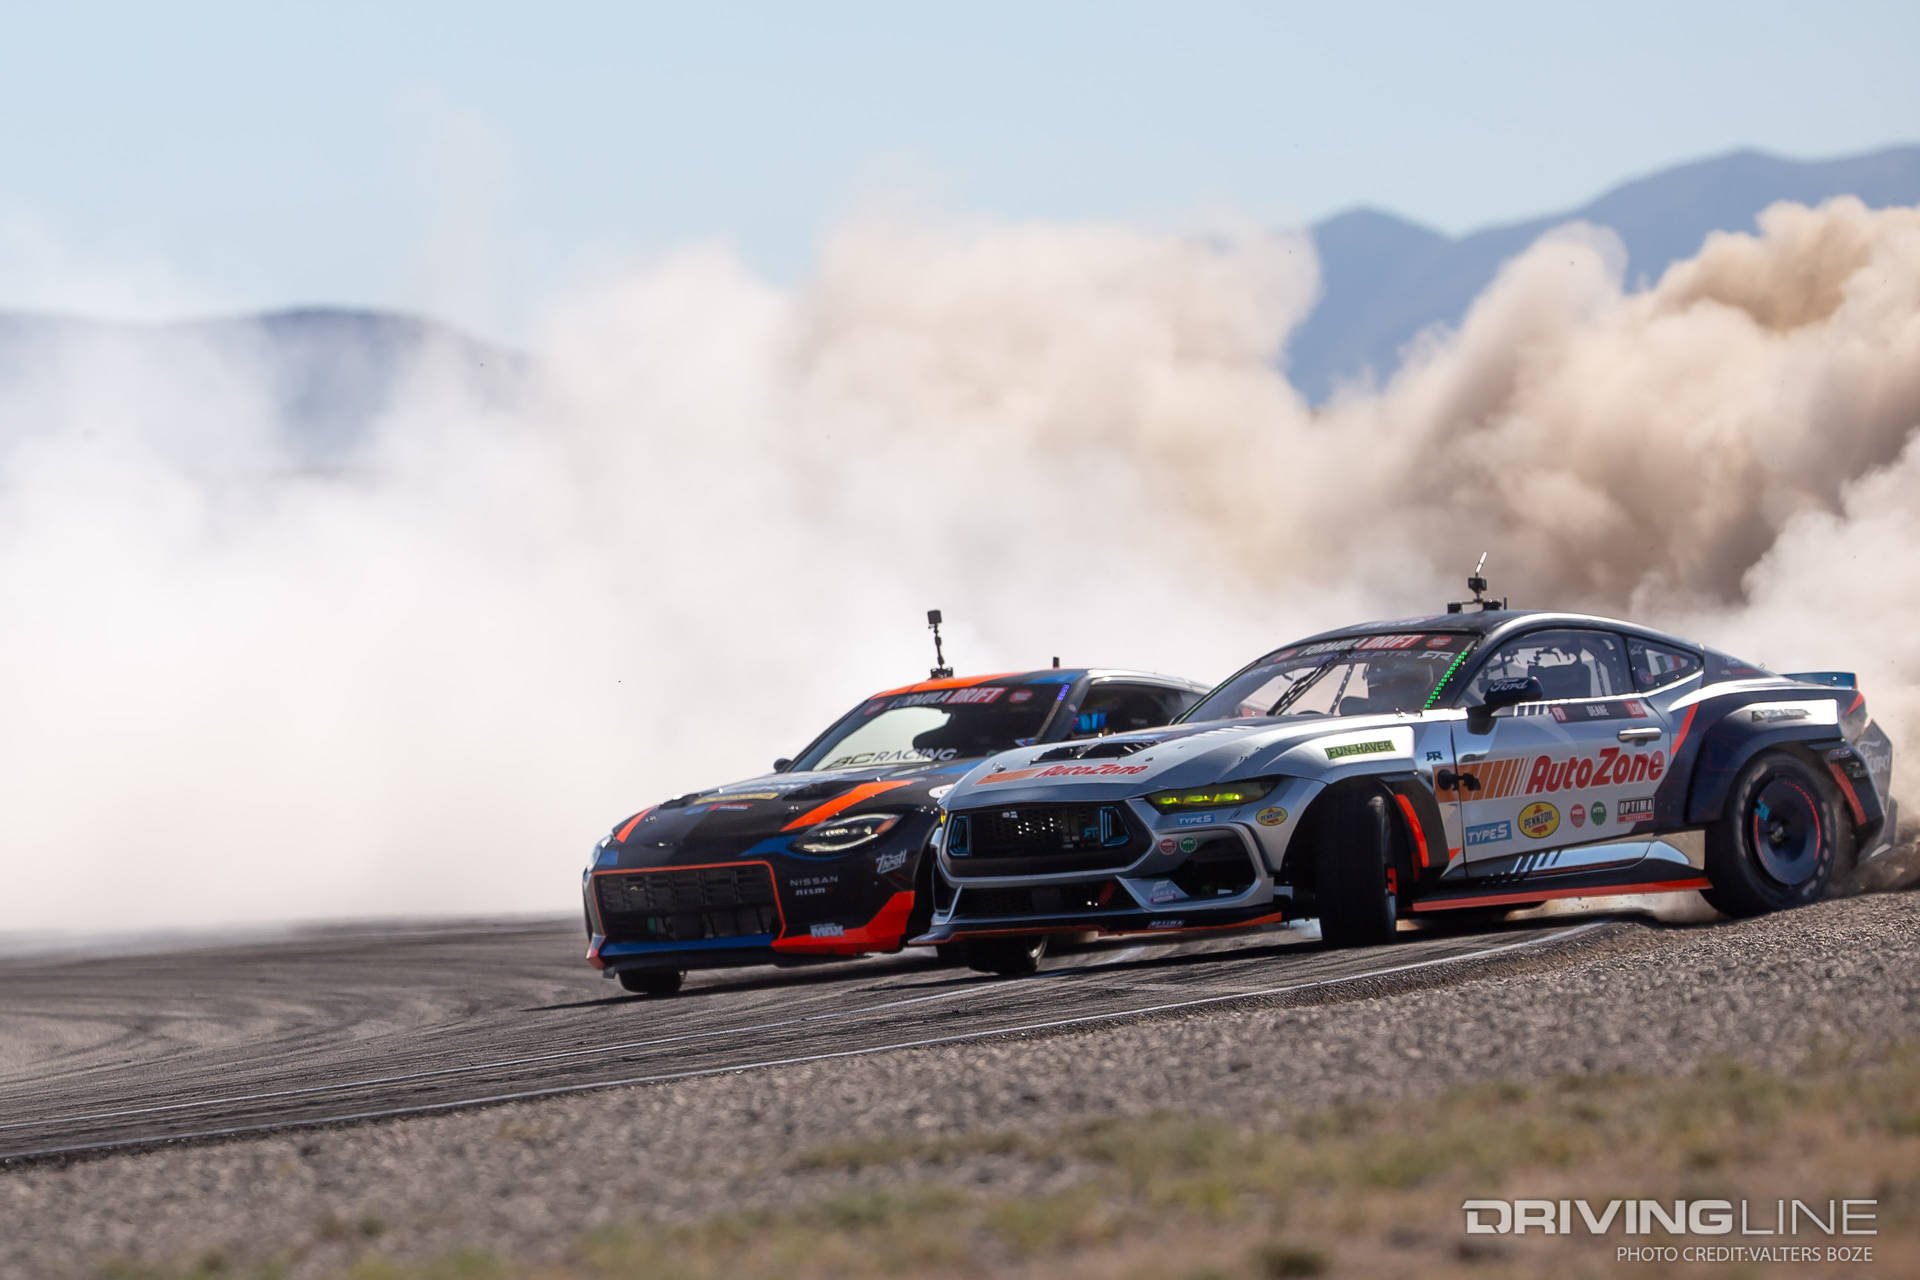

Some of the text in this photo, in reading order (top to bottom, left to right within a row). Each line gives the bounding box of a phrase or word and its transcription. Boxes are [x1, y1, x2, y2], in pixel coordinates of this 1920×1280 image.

[1362, 635, 1421, 650] DRIFT
[1490, 677, 1529, 692] Ford
[948, 687, 1005, 703] DRIFT
[1328, 742, 1394, 757] FUN-HAVER
[1035, 763, 1149, 779] AutoZone
[1525, 746, 1665, 795] AutoZone
[1620, 799, 1653, 815] OPTIMA
[1523, 812, 1555, 829] PENNZOIL
[790, 876, 839, 887] NISSAN
[796, 887, 832, 896] nism
